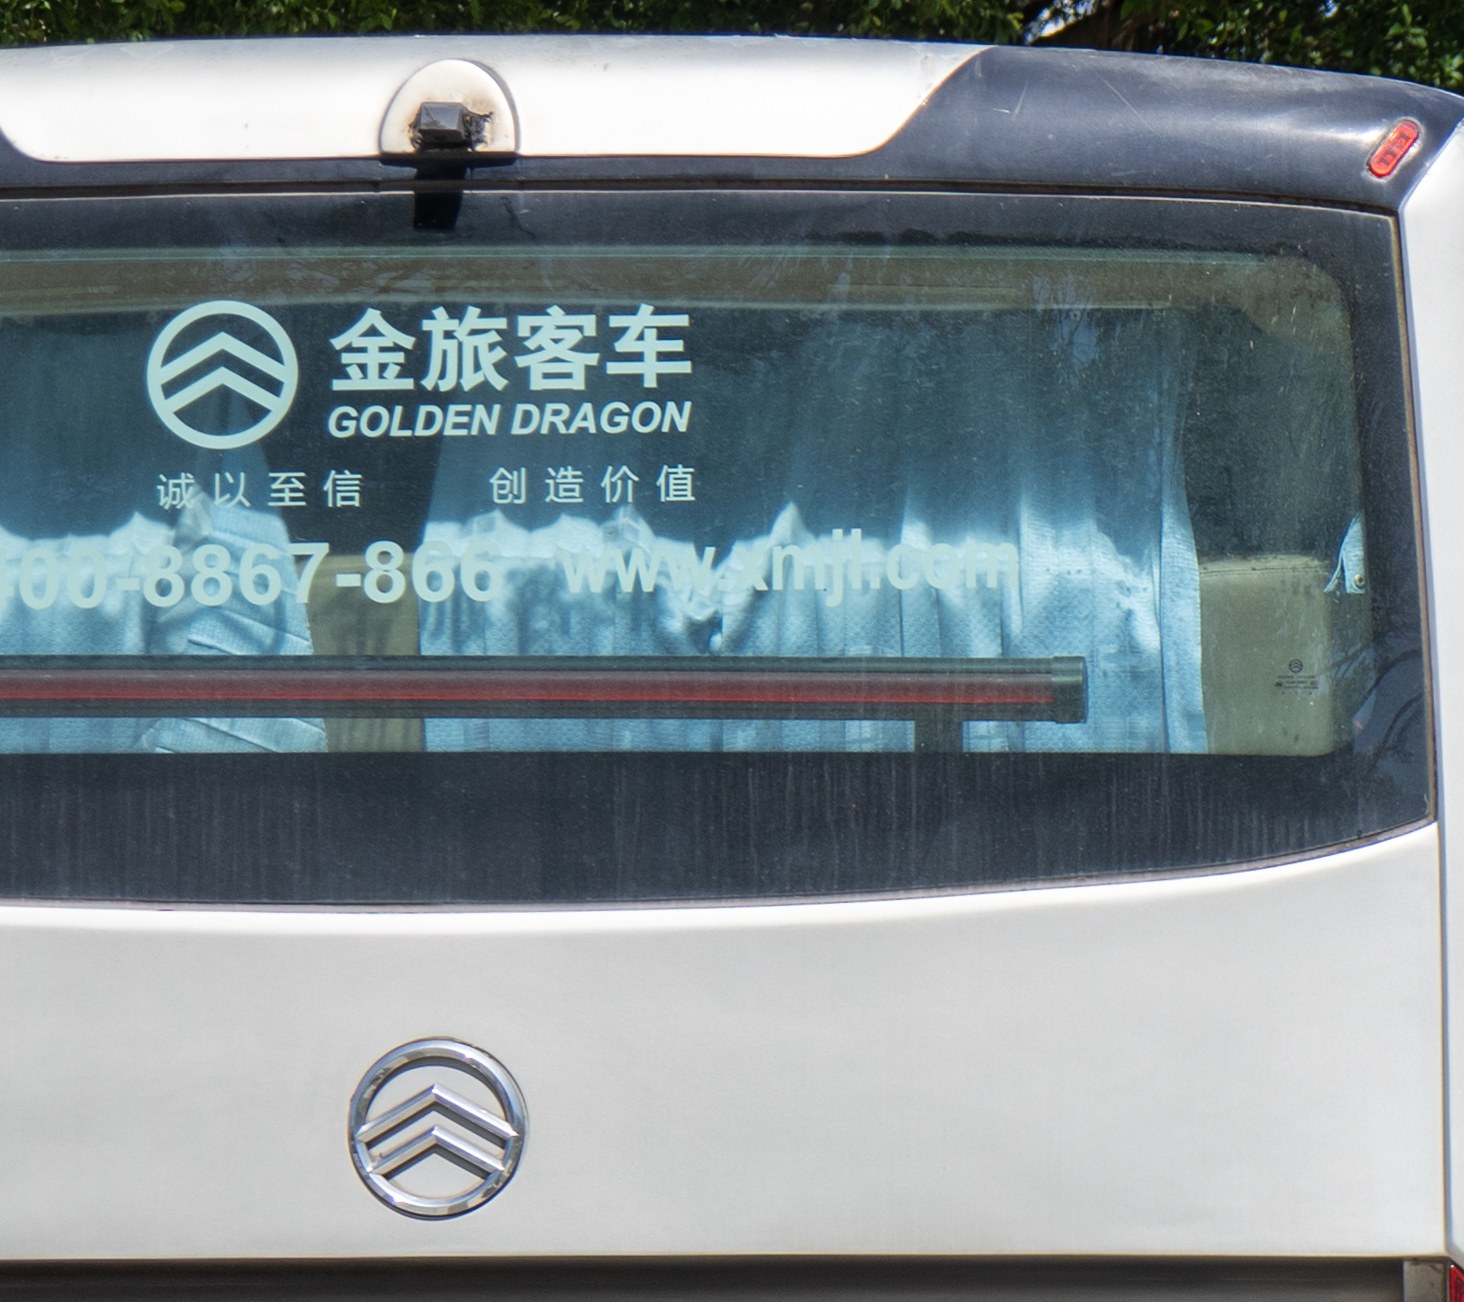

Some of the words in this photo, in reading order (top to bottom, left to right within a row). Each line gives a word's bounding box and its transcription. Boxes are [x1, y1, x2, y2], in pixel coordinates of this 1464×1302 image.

[329, 303, 693, 392] 金旅客车
[328, 403, 497, 439] GOLDEN
[510, 400, 691, 437] DRAGON
[156, 470, 363, 510] 诚以至信
[489, 464, 697, 505] 创造价值
[0, 540, 501, 610] 00-8867-866
[558, 527, 1019, 607] www.xmjl.com
